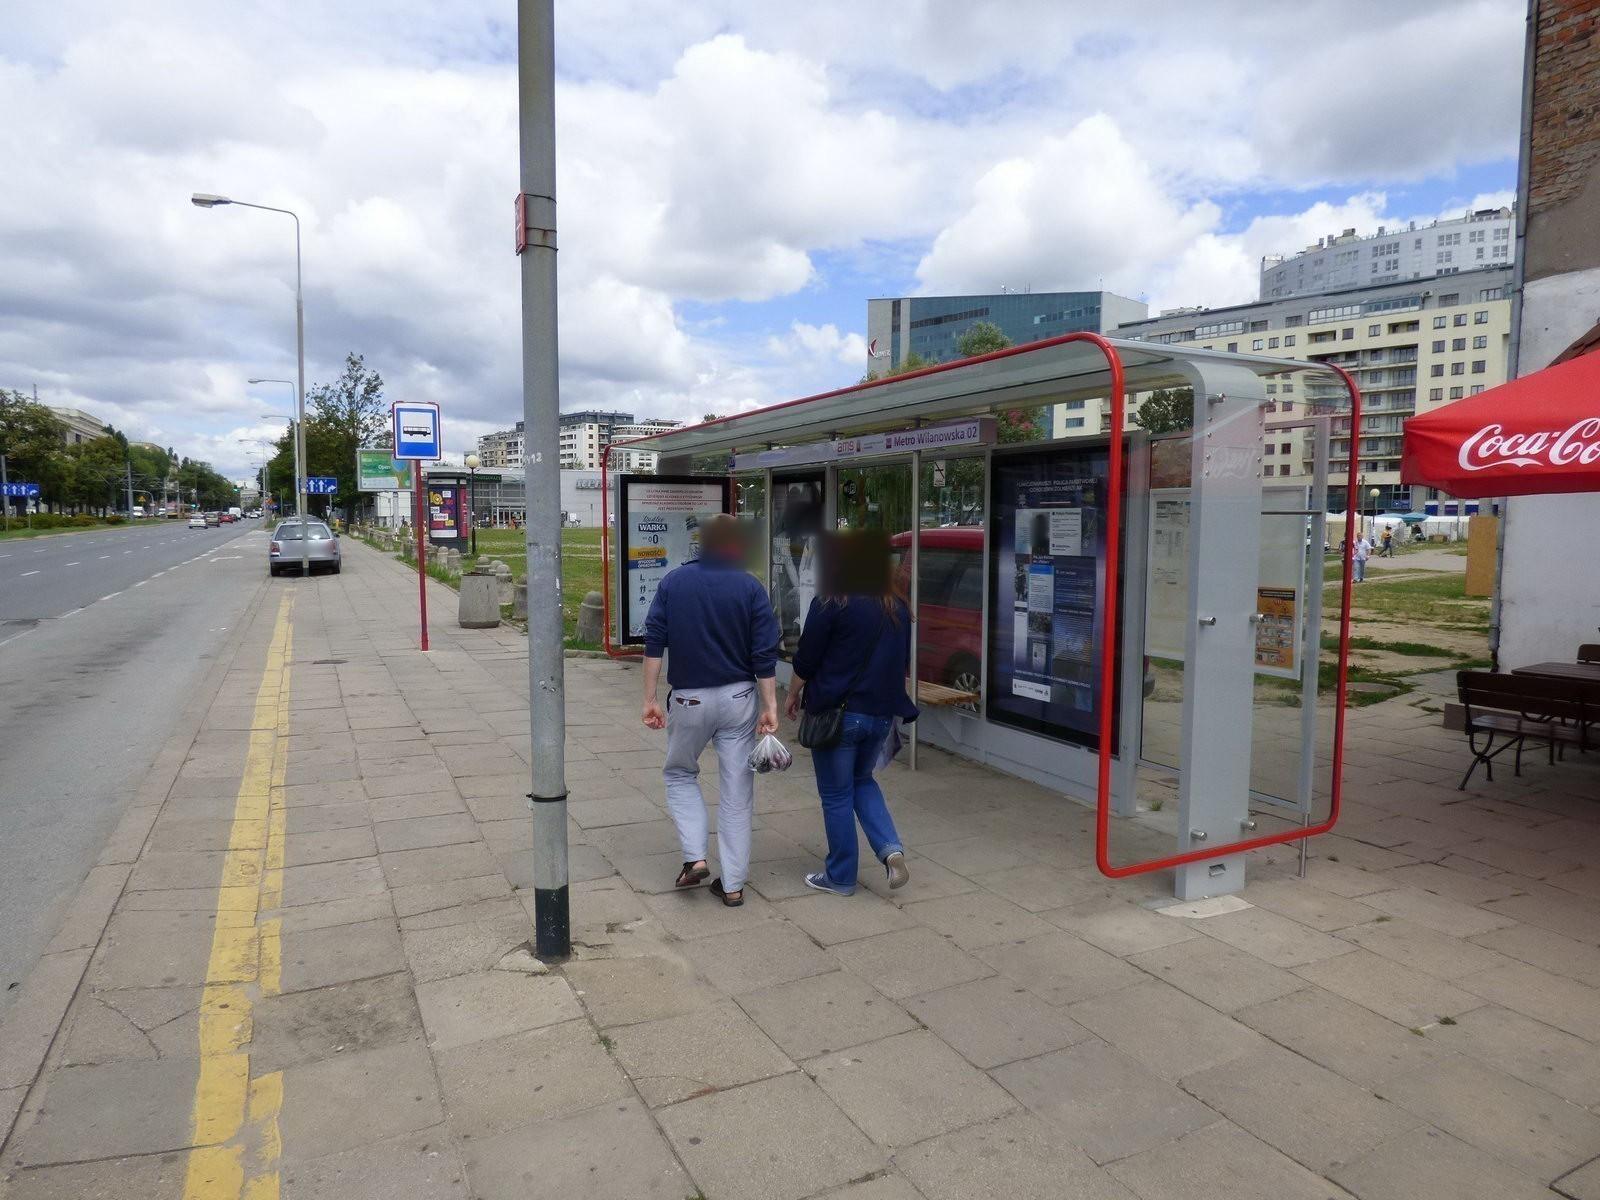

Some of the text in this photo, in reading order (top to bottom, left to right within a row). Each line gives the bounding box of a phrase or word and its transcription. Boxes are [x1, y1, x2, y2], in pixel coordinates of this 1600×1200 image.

[894, 435, 916, 447] Metro
[917, 429, 964, 444] Wilanowska
[967, 426, 978, 439] 02
